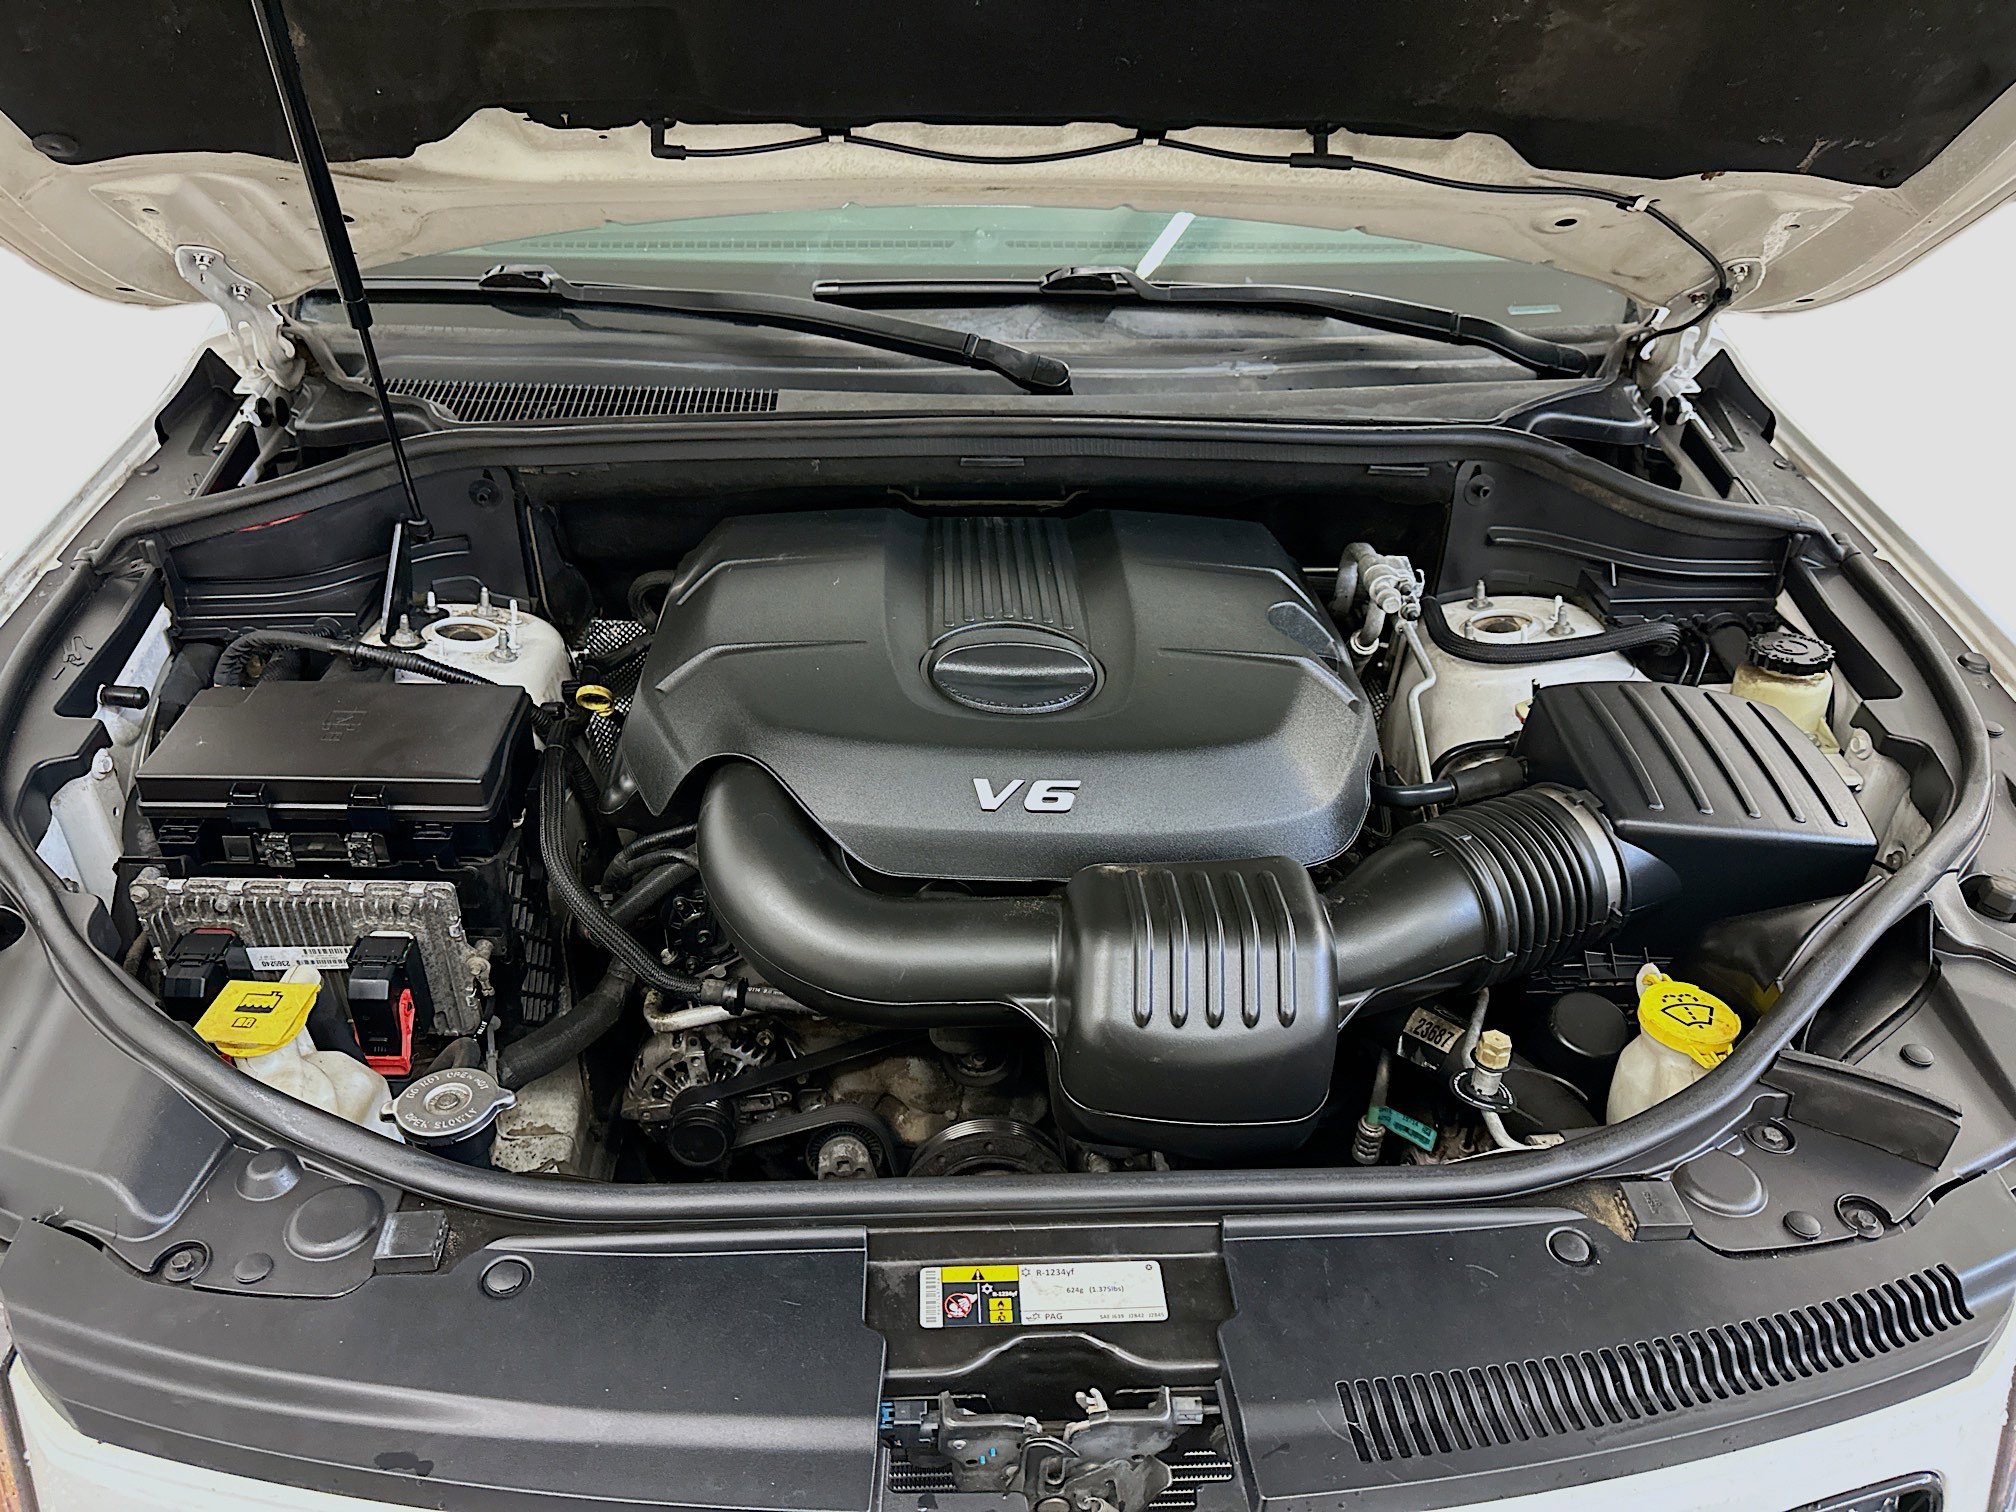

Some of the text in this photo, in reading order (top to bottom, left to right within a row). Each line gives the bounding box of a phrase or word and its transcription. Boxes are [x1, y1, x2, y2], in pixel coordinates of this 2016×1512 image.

[973, 778, 1081, 813] V6
[1413, 1018, 1454, 1048] 23687
[446, 1071, 474, 1080] OPEN
[434, 1108, 478, 1129] SLOWLY
[1036, 1268, 1074, 1277] R-1234yf
[1089, 1285, 1125, 1294] (1.375lbs)
